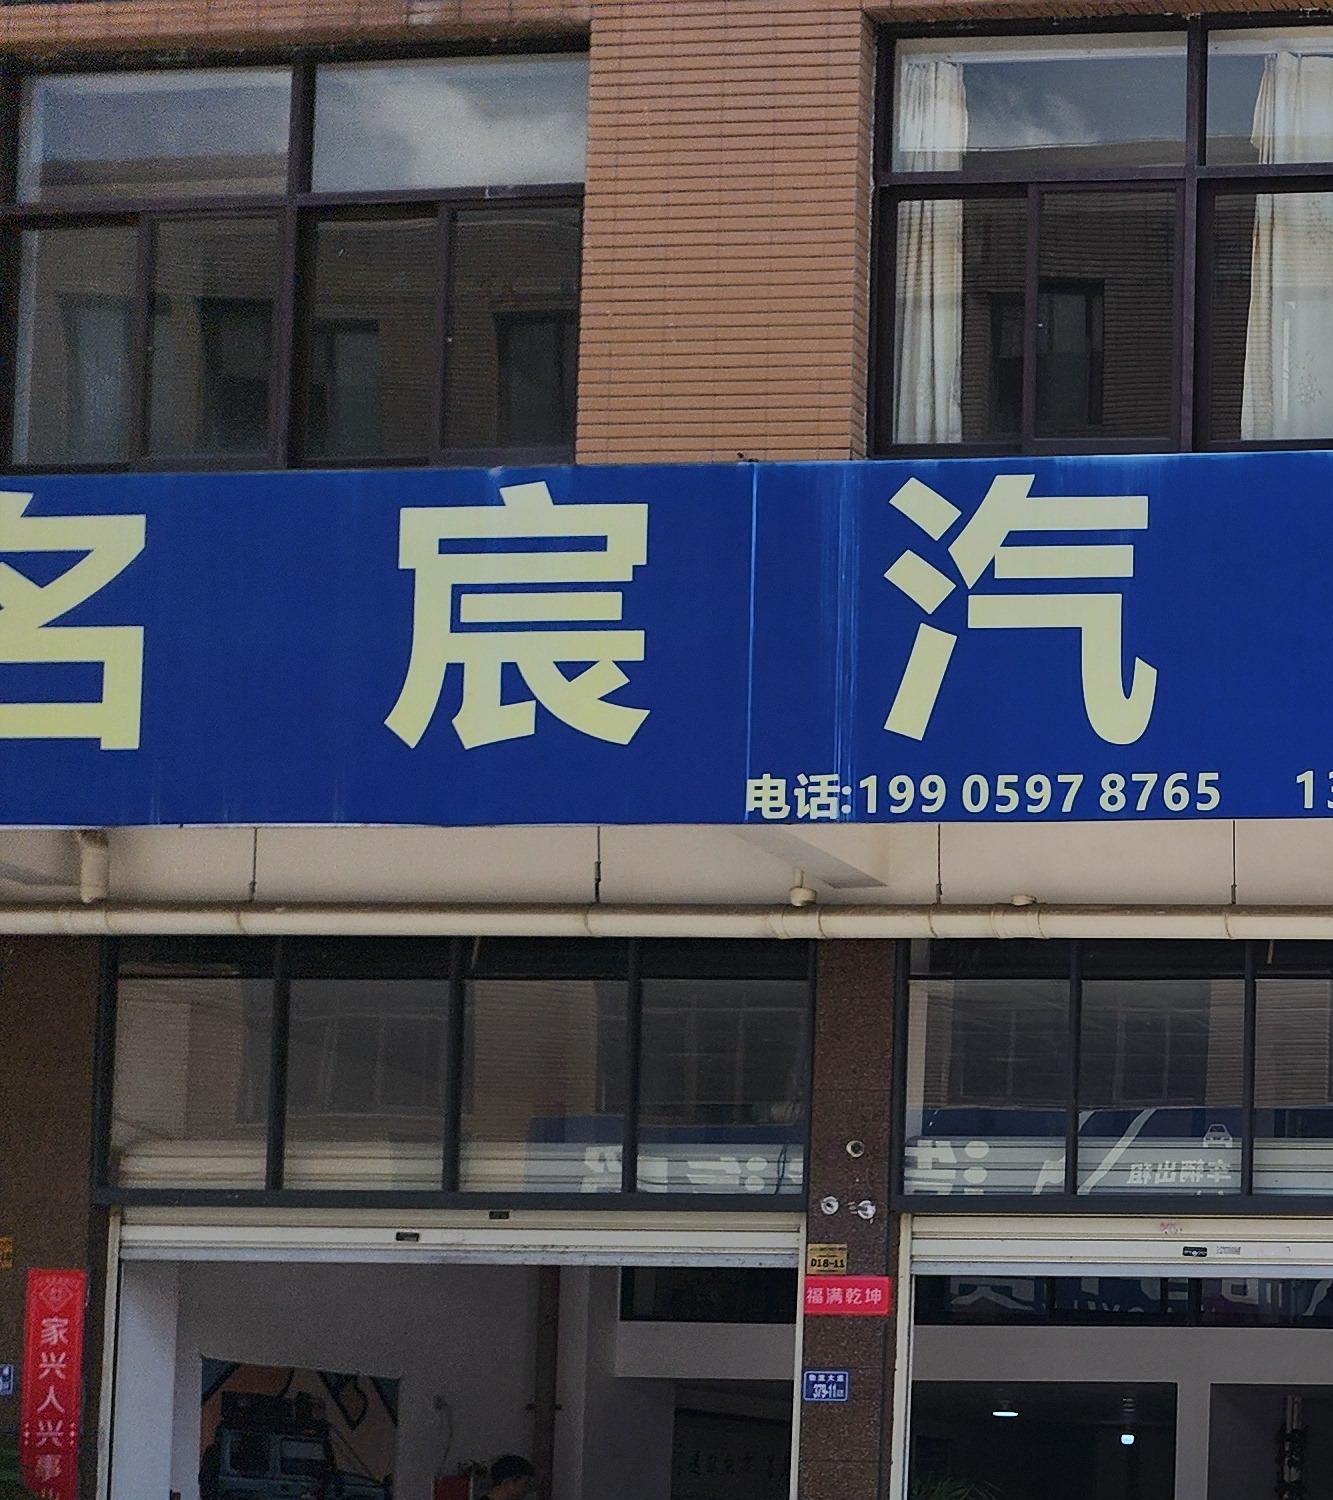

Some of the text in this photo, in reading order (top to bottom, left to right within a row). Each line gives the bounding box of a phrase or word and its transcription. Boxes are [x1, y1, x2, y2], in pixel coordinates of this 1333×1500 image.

[961, 773, 1084, 816] 0597
[1099, 771, 1222, 814] 8765
[806, 1287, 883, 1305] 福满乾坤
